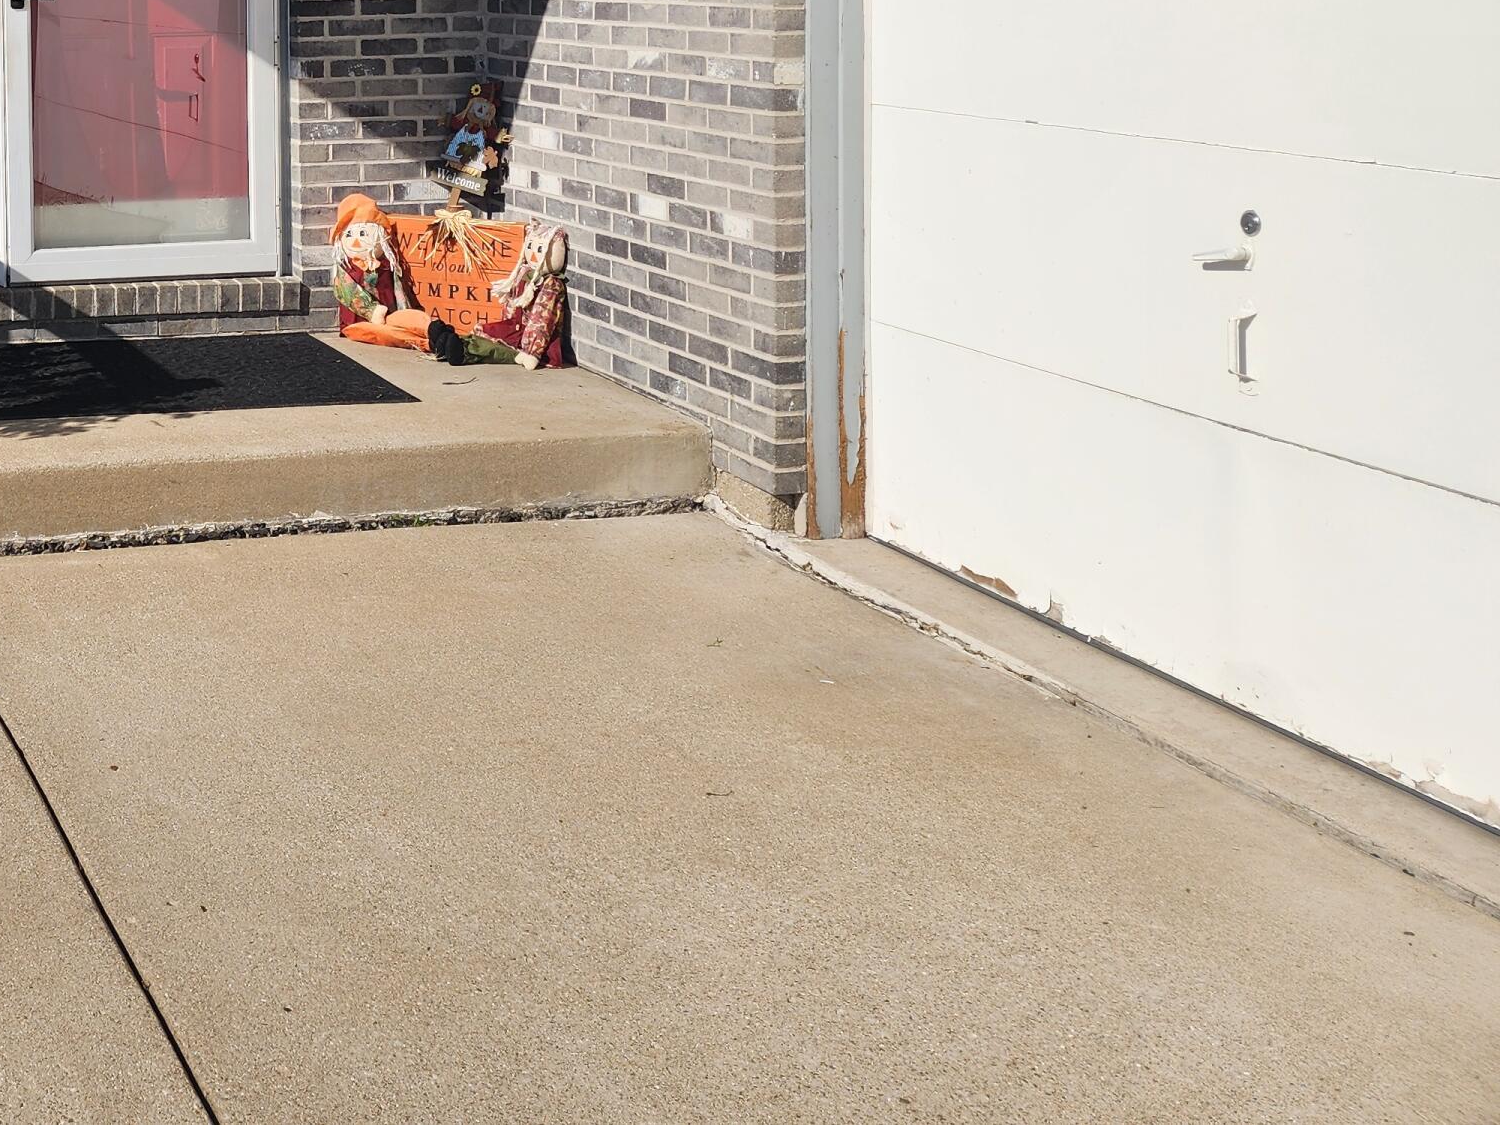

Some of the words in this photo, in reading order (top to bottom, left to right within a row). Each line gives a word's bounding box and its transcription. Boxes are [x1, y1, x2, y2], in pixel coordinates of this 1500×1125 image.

[436, 166, 482, 192] Welcome
[398, 233, 512, 258] WELCME
[449, 263, 471, 274] ou
[413, 281, 493, 303] UMPKI
[430, 307, 489, 325] ATCH
